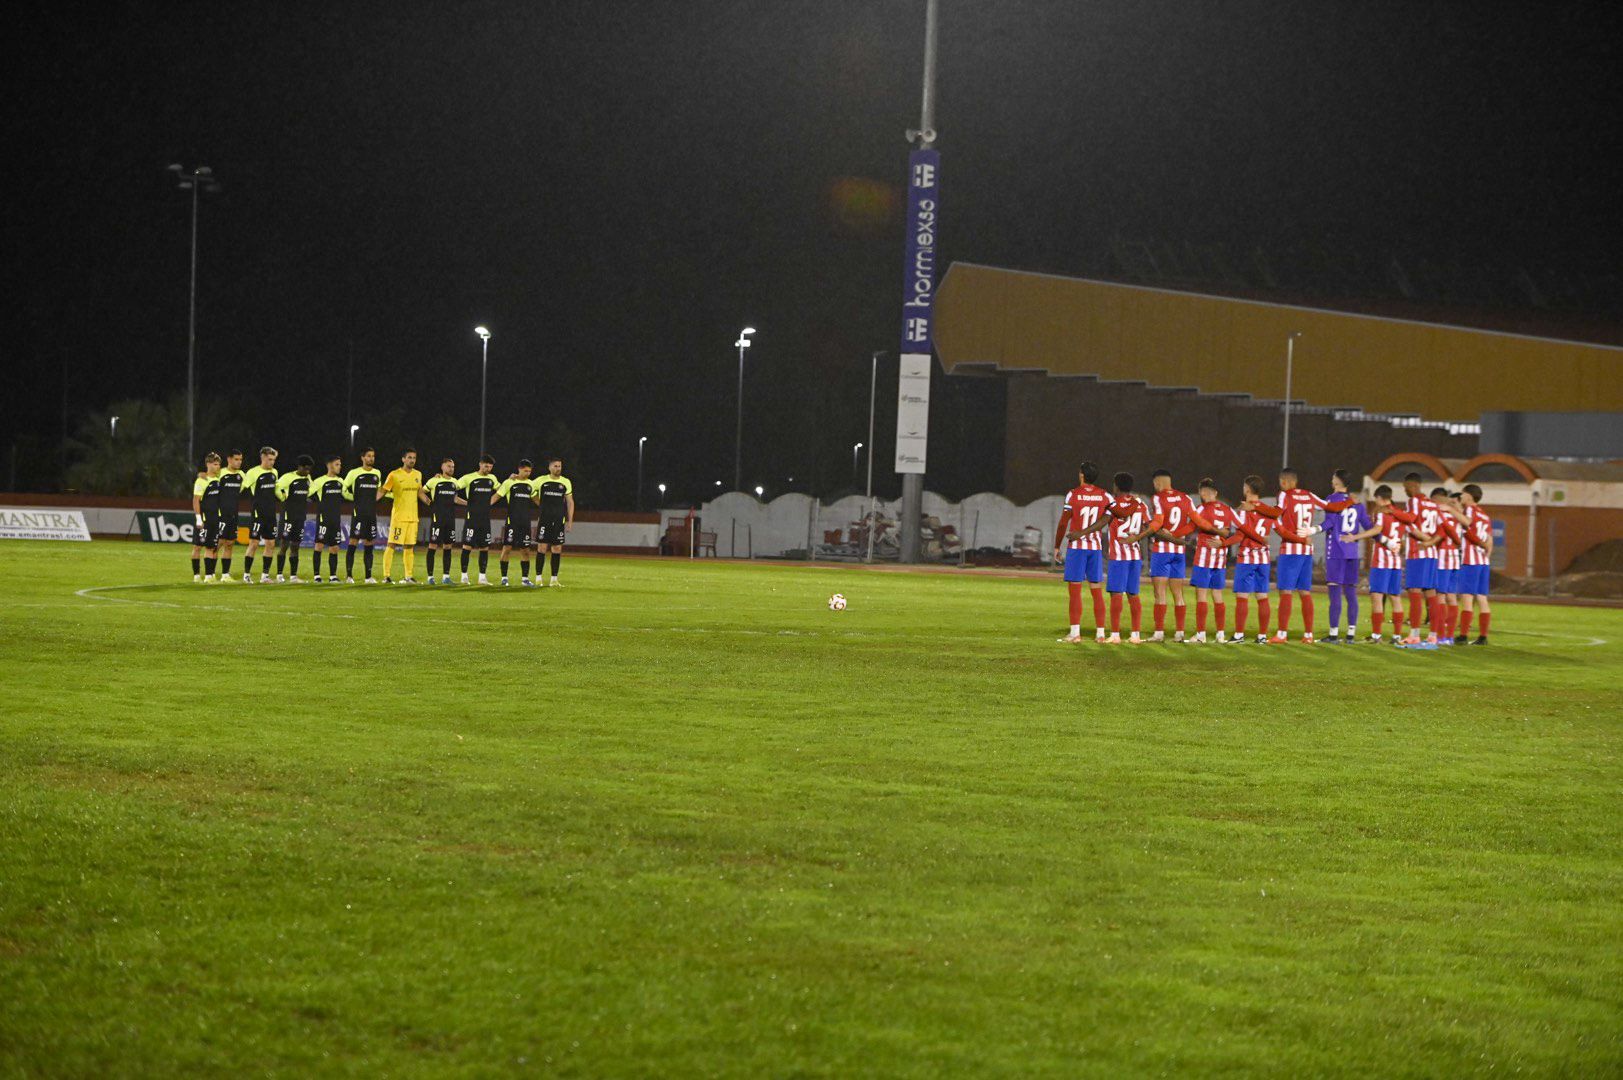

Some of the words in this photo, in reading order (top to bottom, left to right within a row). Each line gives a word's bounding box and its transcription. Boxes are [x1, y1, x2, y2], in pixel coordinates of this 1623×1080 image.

[1080, 506, 1099, 530] 11
[1117, 512, 1142, 538] 24
[1169, 506, 1181, 531] 9
[1294, 504, 1312, 532] 15
[1341, 507, 1358, 532] 13
[1421, 509, 1438, 535] 20
[284, 522, 292, 532] 12
[319, 526, 327, 535] 10
[394, 527, 402, 536] 13
[432, 527, 440, 537] 14
[466, 528, 474, 538] 19
[508, 529, 514, 537] 2
[540, 526, 546, 535] 5
[1255, 518, 1266, 537] 6
